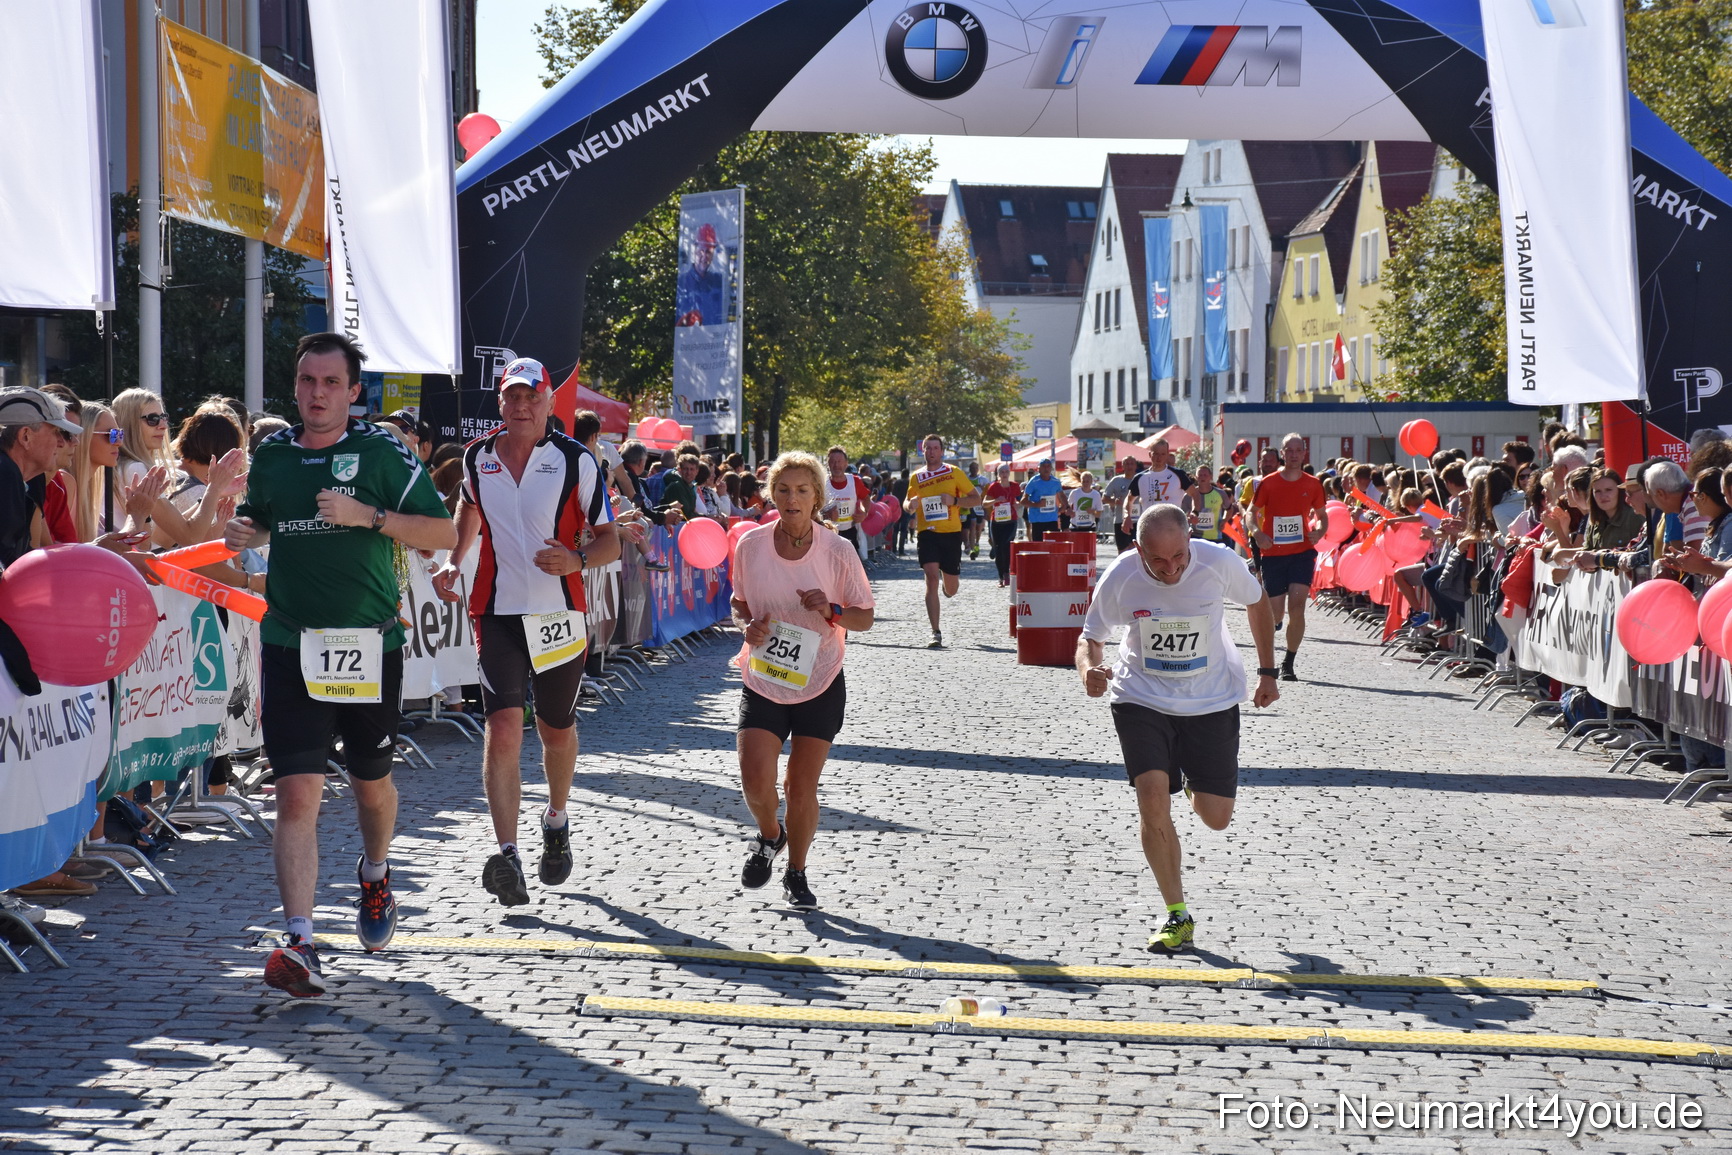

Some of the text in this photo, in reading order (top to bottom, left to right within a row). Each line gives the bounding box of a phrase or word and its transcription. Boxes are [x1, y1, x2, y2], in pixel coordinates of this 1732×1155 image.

[895, 3, 979, 33] BMW
[482, 73, 711, 217] PARTL NEUMARKT
[461, 417, 502, 429] HE NEXT
[441, 426, 456, 436] 100
[1661, 443, 1684, 453] THE
[838, 507, 850, 515] 191
[925, 502, 943, 512] 2411
[1277, 523, 1299, 533] 3125
[166, 568, 231, 608] DEHN
[540, 619, 572, 645] 321
[324, 634, 358, 644] BOCK
[1150, 631, 1200, 652] 2477
[765, 636, 802, 663] 254
[320, 649, 362, 672] 172
[1161, 661, 1191, 671] Werner
[765, 664, 789, 680] Ingrid
[325, 685, 355, 697] Phillip
